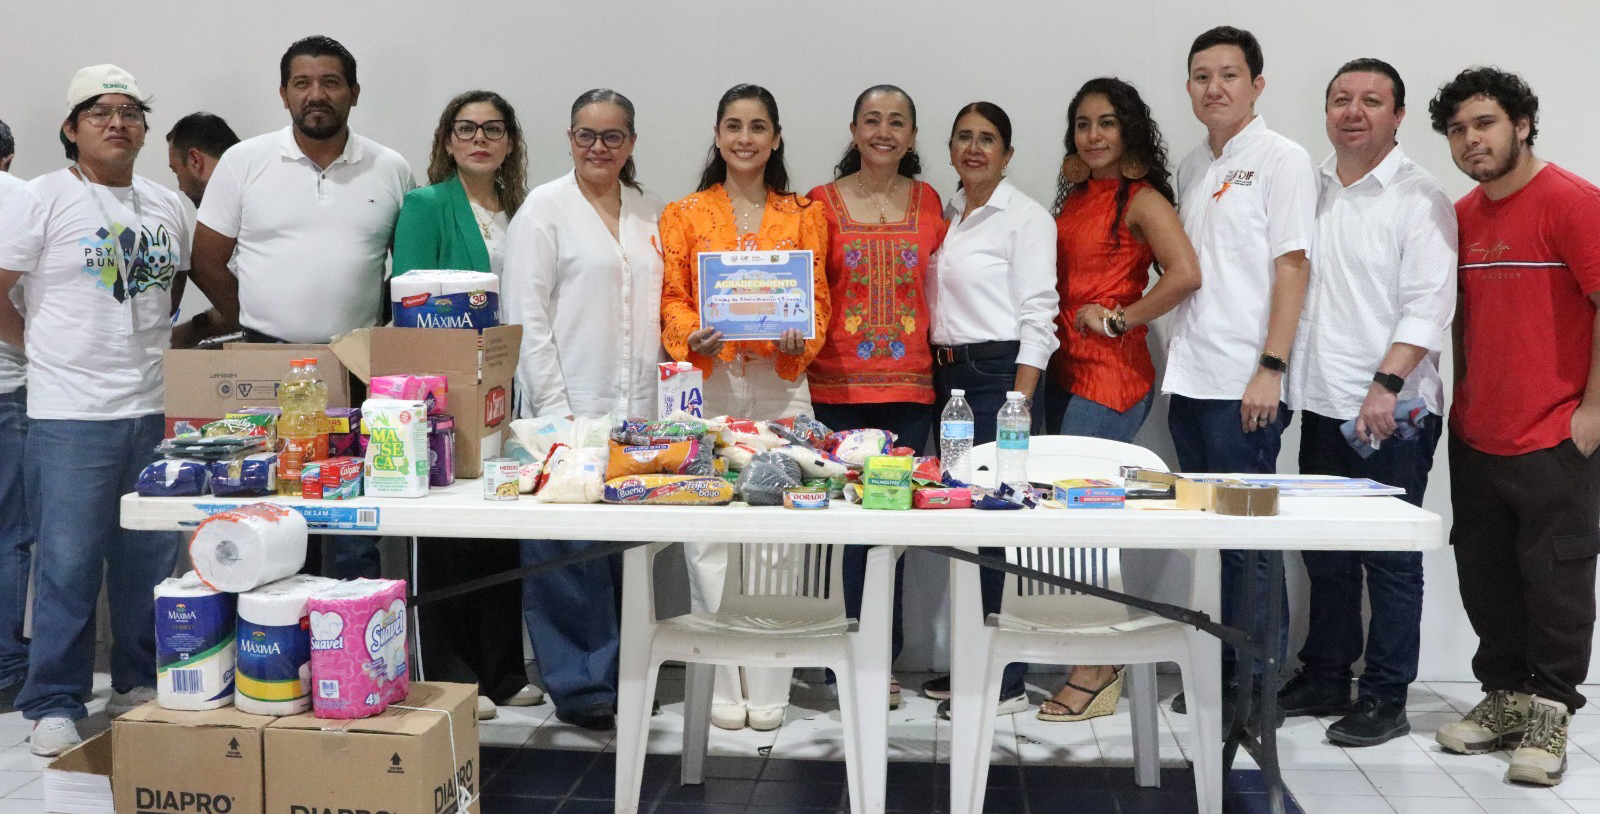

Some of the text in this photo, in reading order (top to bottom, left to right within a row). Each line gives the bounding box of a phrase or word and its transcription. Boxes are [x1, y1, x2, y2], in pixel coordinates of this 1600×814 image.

[85, 247, 139, 256] PSYH
[714, 279, 798, 288] AGRADECIMIENTO
[472, 294, 486, 305] 3D
[417, 312, 473, 328] MÁXIMA
[371, 428, 400, 443] MA
[380, 442, 404, 457] SE
[373, 455, 397, 471] CA
[340, 466, 360, 477] Colgate
[620, 486, 644, 498] Bueno
[699, 488, 720, 498] bayo
[371, 610, 404, 652] Suavel
[241, 638, 281, 655] MÁXIMA
[310, 636, 344, 650] Suavel
[365, 692, 374, 706] 4
[136, 787, 232, 814] DIAPRO
